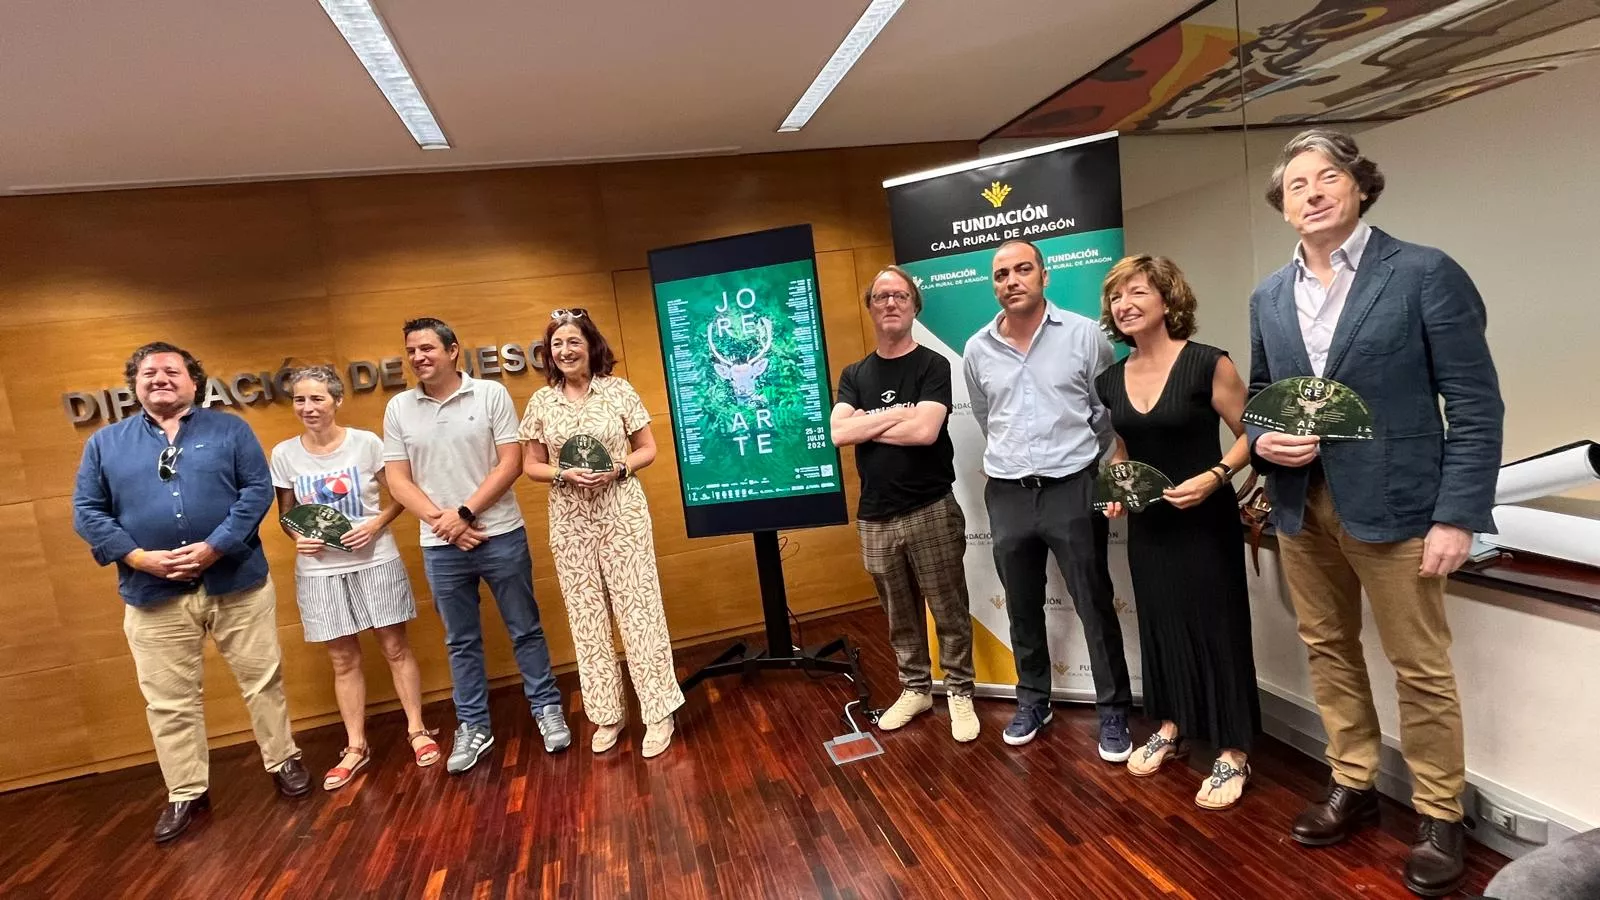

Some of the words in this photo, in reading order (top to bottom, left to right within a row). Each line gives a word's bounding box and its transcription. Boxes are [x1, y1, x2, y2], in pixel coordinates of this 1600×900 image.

[952, 204, 1048, 234] FUNDACIÓN
[930, 240, 960, 252] CAJA
[963, 233, 1001, 247] RURAL
[1004, 229, 1020, 239] DE
[1023, 218, 1075, 235] ARAGÓN
[1047, 248, 1099, 264] FUNDACIÓN
[930, 268, 977, 282] FUNDACIÓN
[715, 288, 756, 313] JO
[716, 312, 756, 338] RE
[349, 357, 407, 392] DE
[1304, 388, 1322, 397] RE
[1305, 381, 1325, 389] JO
[731, 409, 774, 432] AR
[1297, 420, 1316, 429] AR
[732, 433, 773, 456] TE
[806, 434, 825, 442] JULIO
[807, 441, 826, 449] 2024
